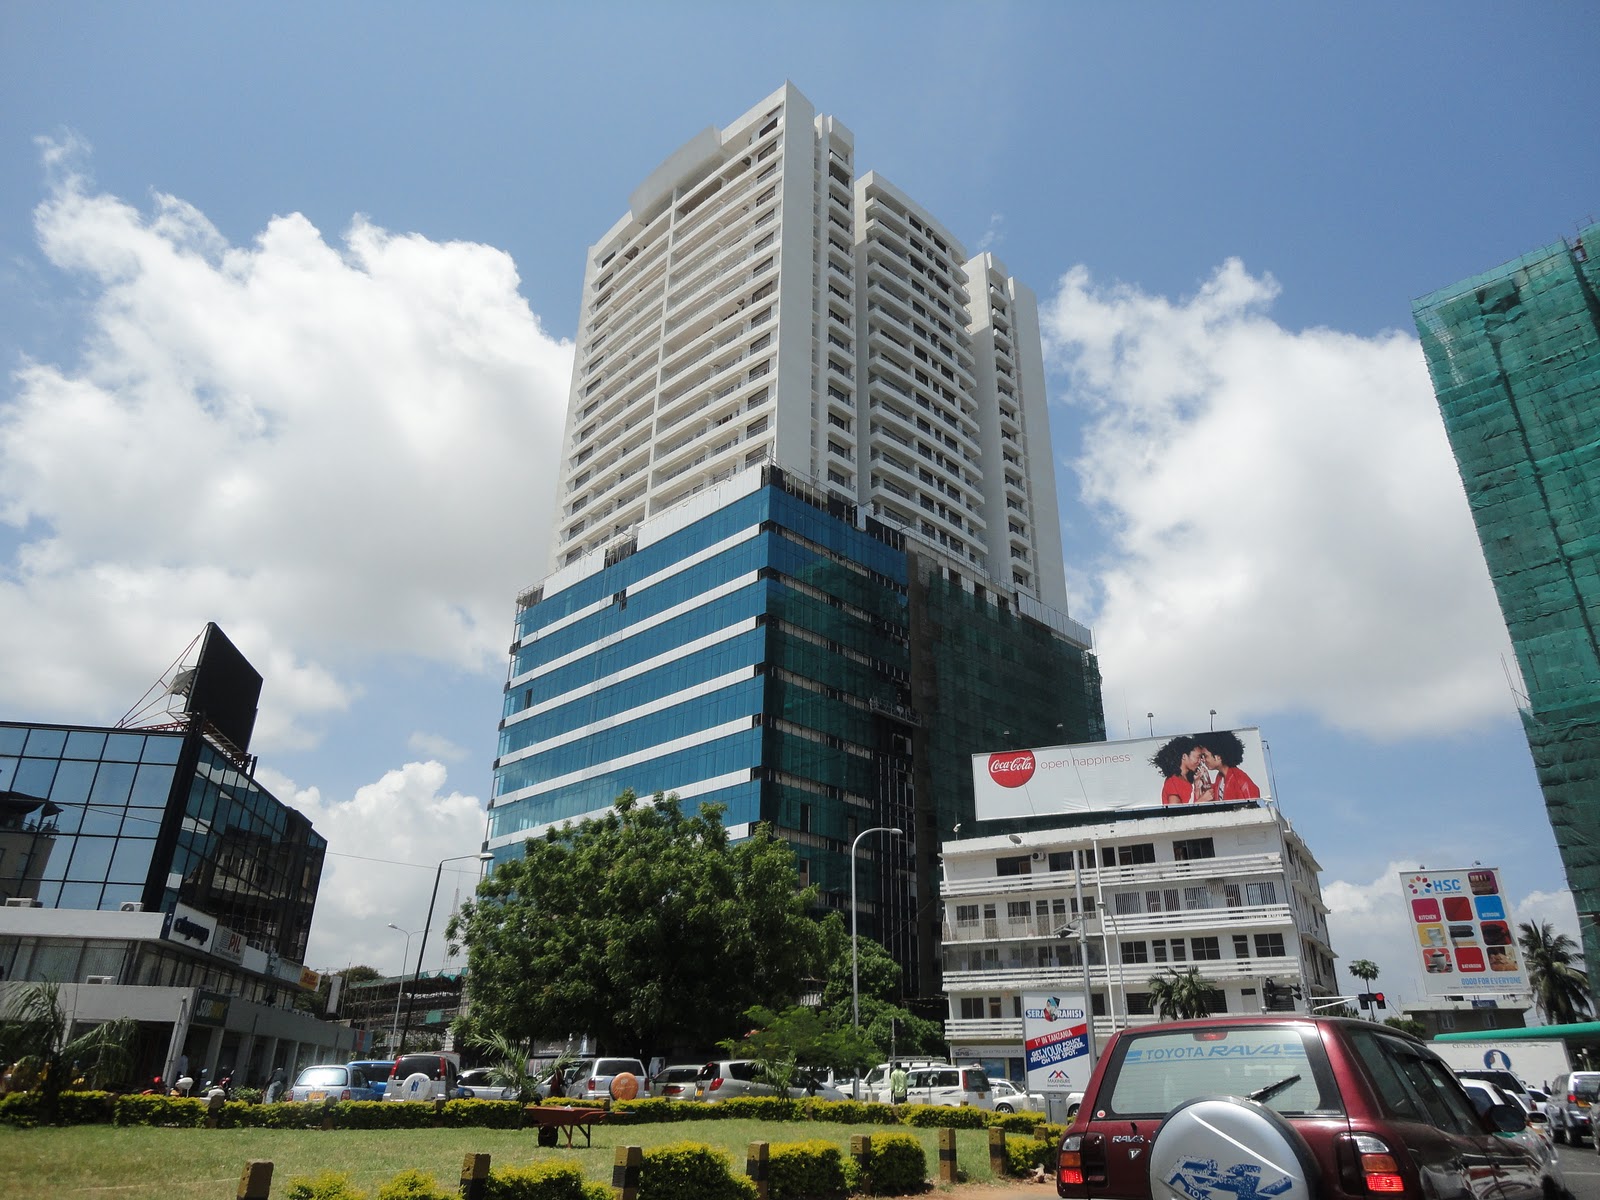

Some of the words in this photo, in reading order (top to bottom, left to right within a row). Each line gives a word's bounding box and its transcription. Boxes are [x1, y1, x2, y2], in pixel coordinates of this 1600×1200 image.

[990, 757, 1033, 773] Coca-Cola
[1040, 759, 1070, 771] open
[1072, 753, 1131, 767] happiness
[1433, 879, 1461, 891] HSC
[1478, 977, 1490, 985] FOR
[1490, 976, 1522, 985] EVERYONE
[1027, 1009, 1045, 1018] SERA
[1057, 1009, 1082, 1018] RAHISI
[1048, 1029, 1073, 1042] TANZANIA
[1042, 1043, 1063, 1057] YOUR
[1146, 1046, 1204, 1060] TOYOTA
[1208, 1044, 1281, 1057] RAV4
